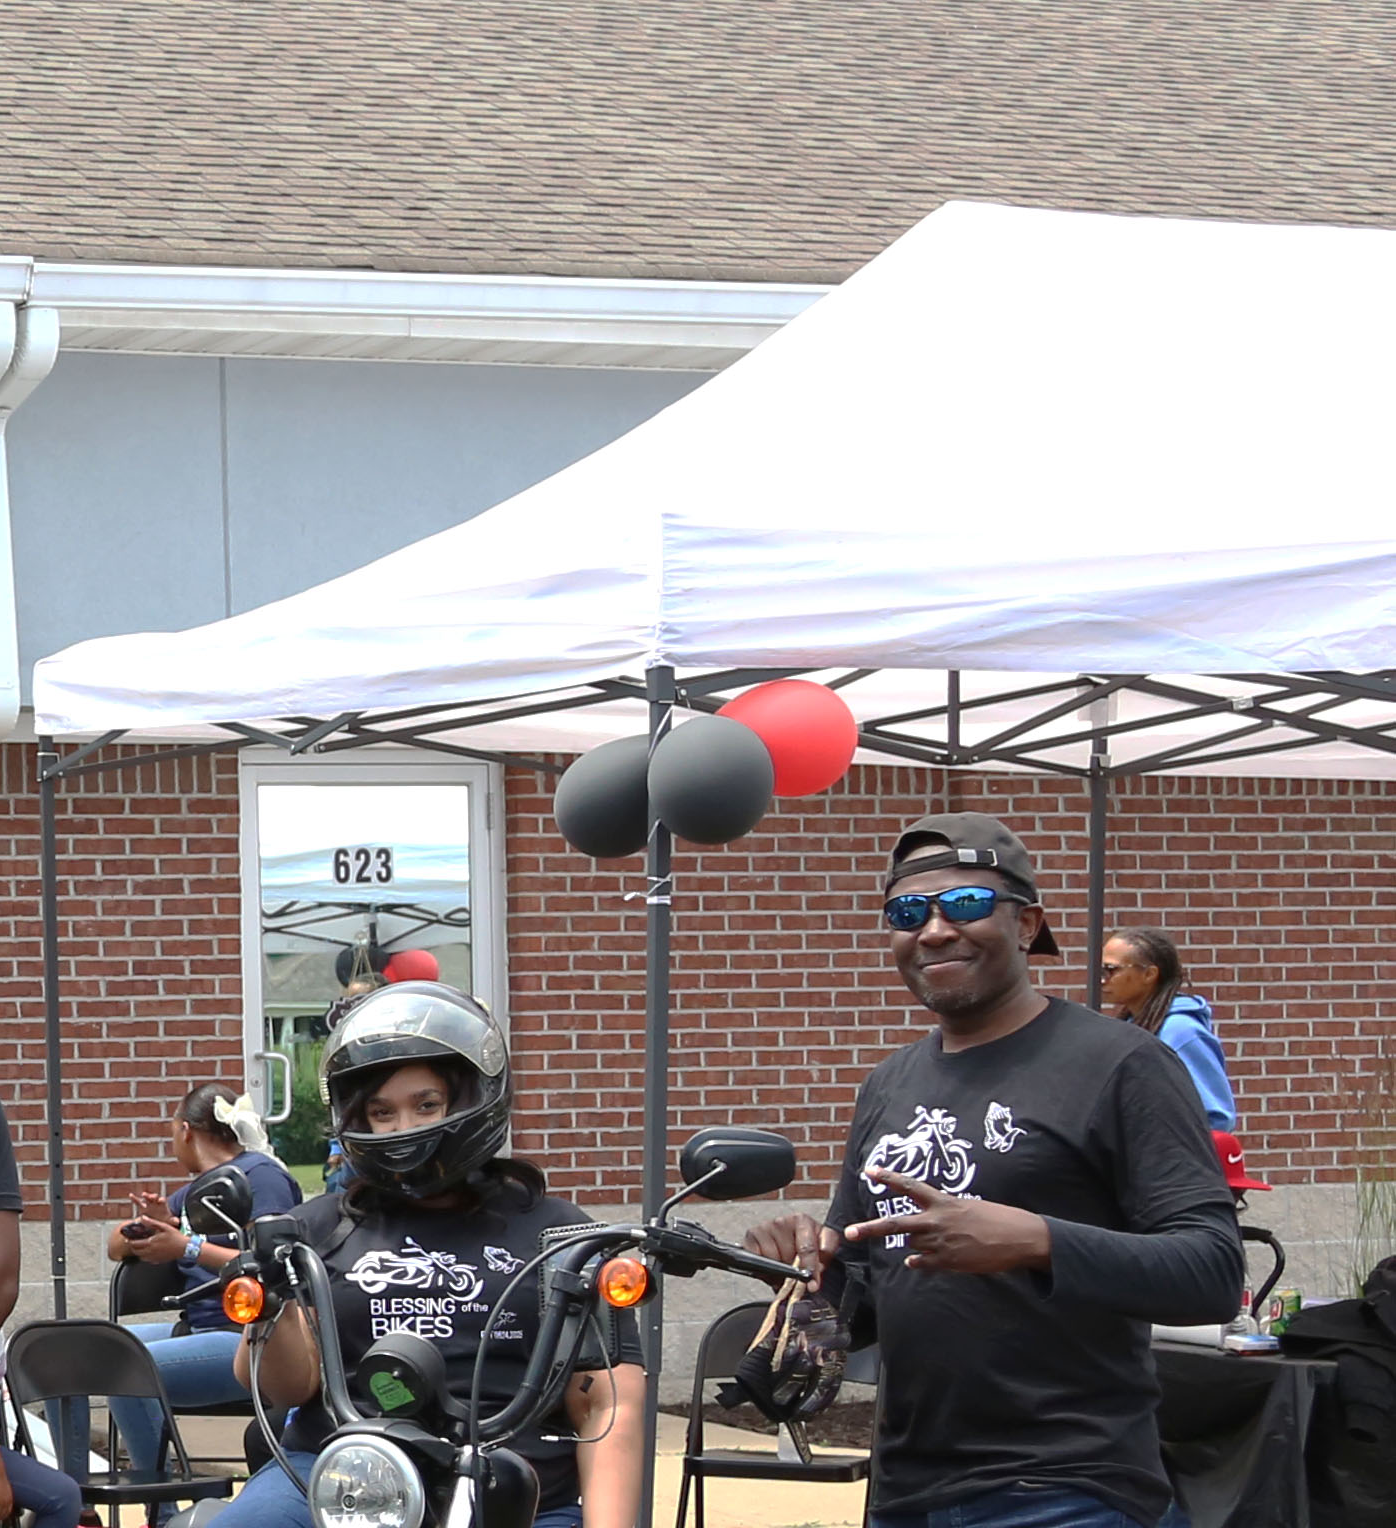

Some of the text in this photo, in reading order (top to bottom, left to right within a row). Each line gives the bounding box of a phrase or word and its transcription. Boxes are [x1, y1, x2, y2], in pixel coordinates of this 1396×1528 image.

[334, 847, 394, 885] 623
[370, 1297, 489, 1316] BLESSING of the
[371, 1316, 454, 1340] BIKES
